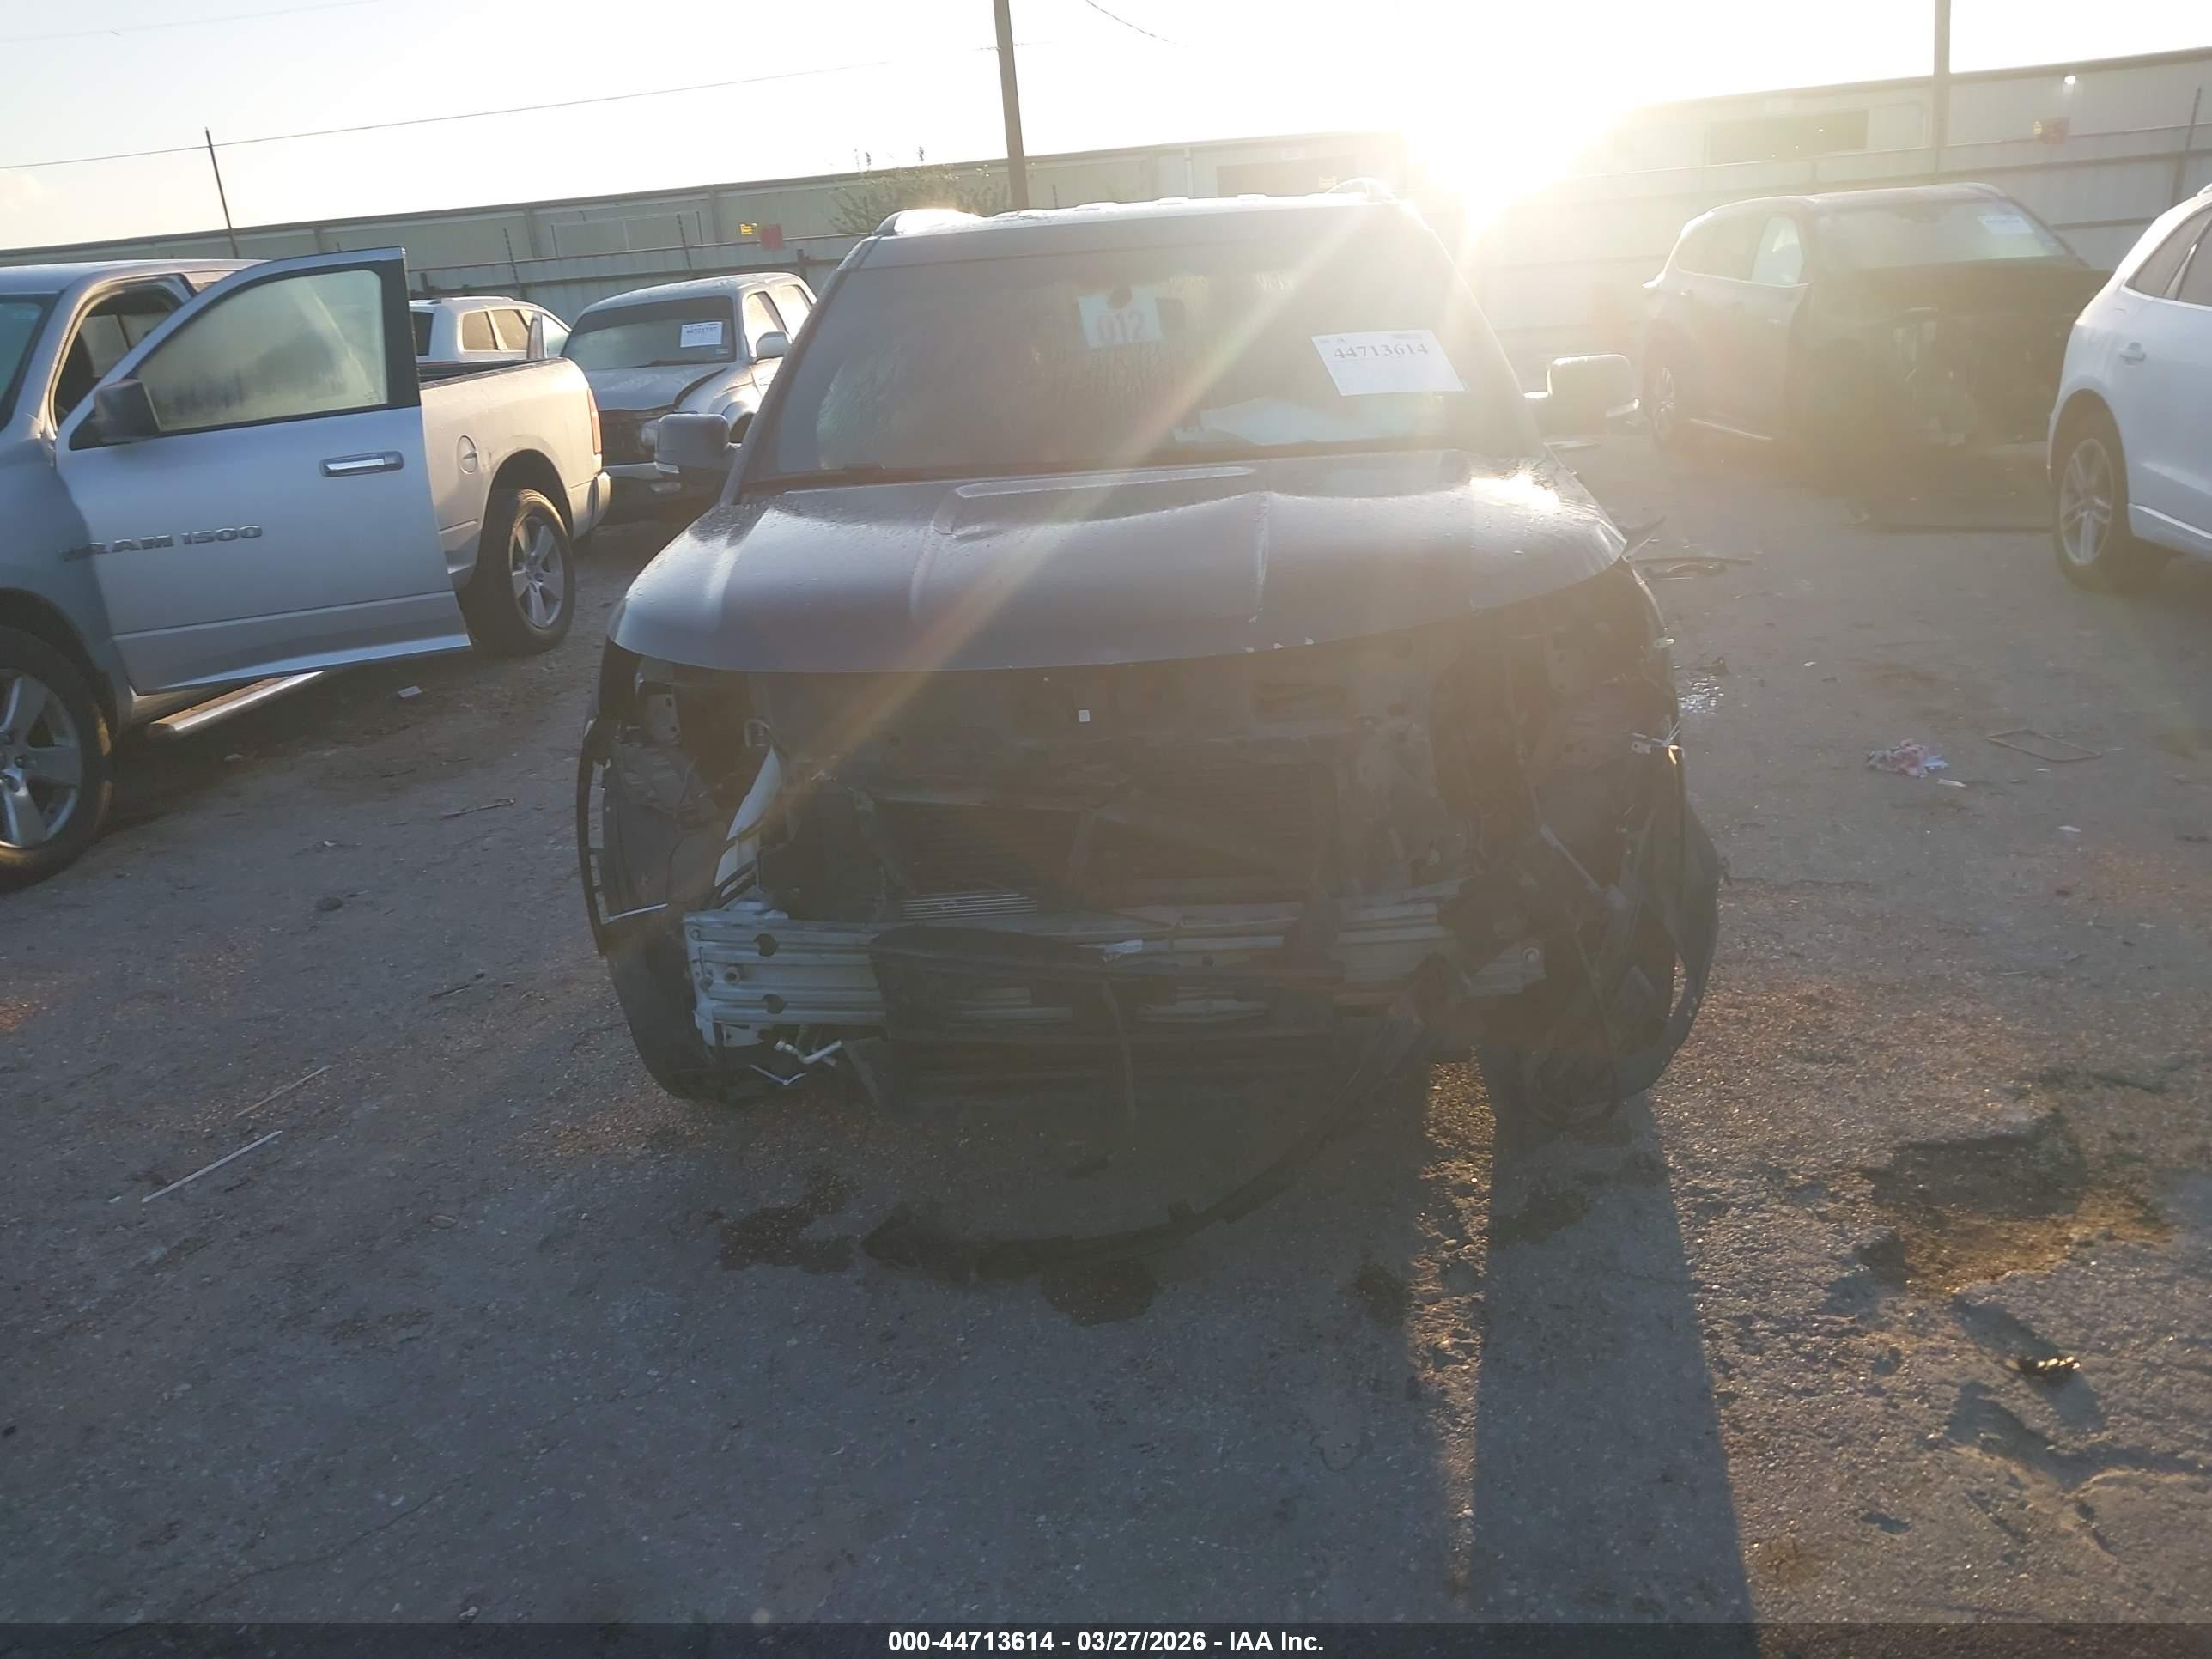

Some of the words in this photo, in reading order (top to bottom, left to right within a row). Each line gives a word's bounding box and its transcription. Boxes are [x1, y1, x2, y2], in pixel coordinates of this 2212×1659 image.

[1334, 343, 1429, 358] 44713614
[88, 534, 174, 556] RAM
[180, 525, 263, 545] 1500
